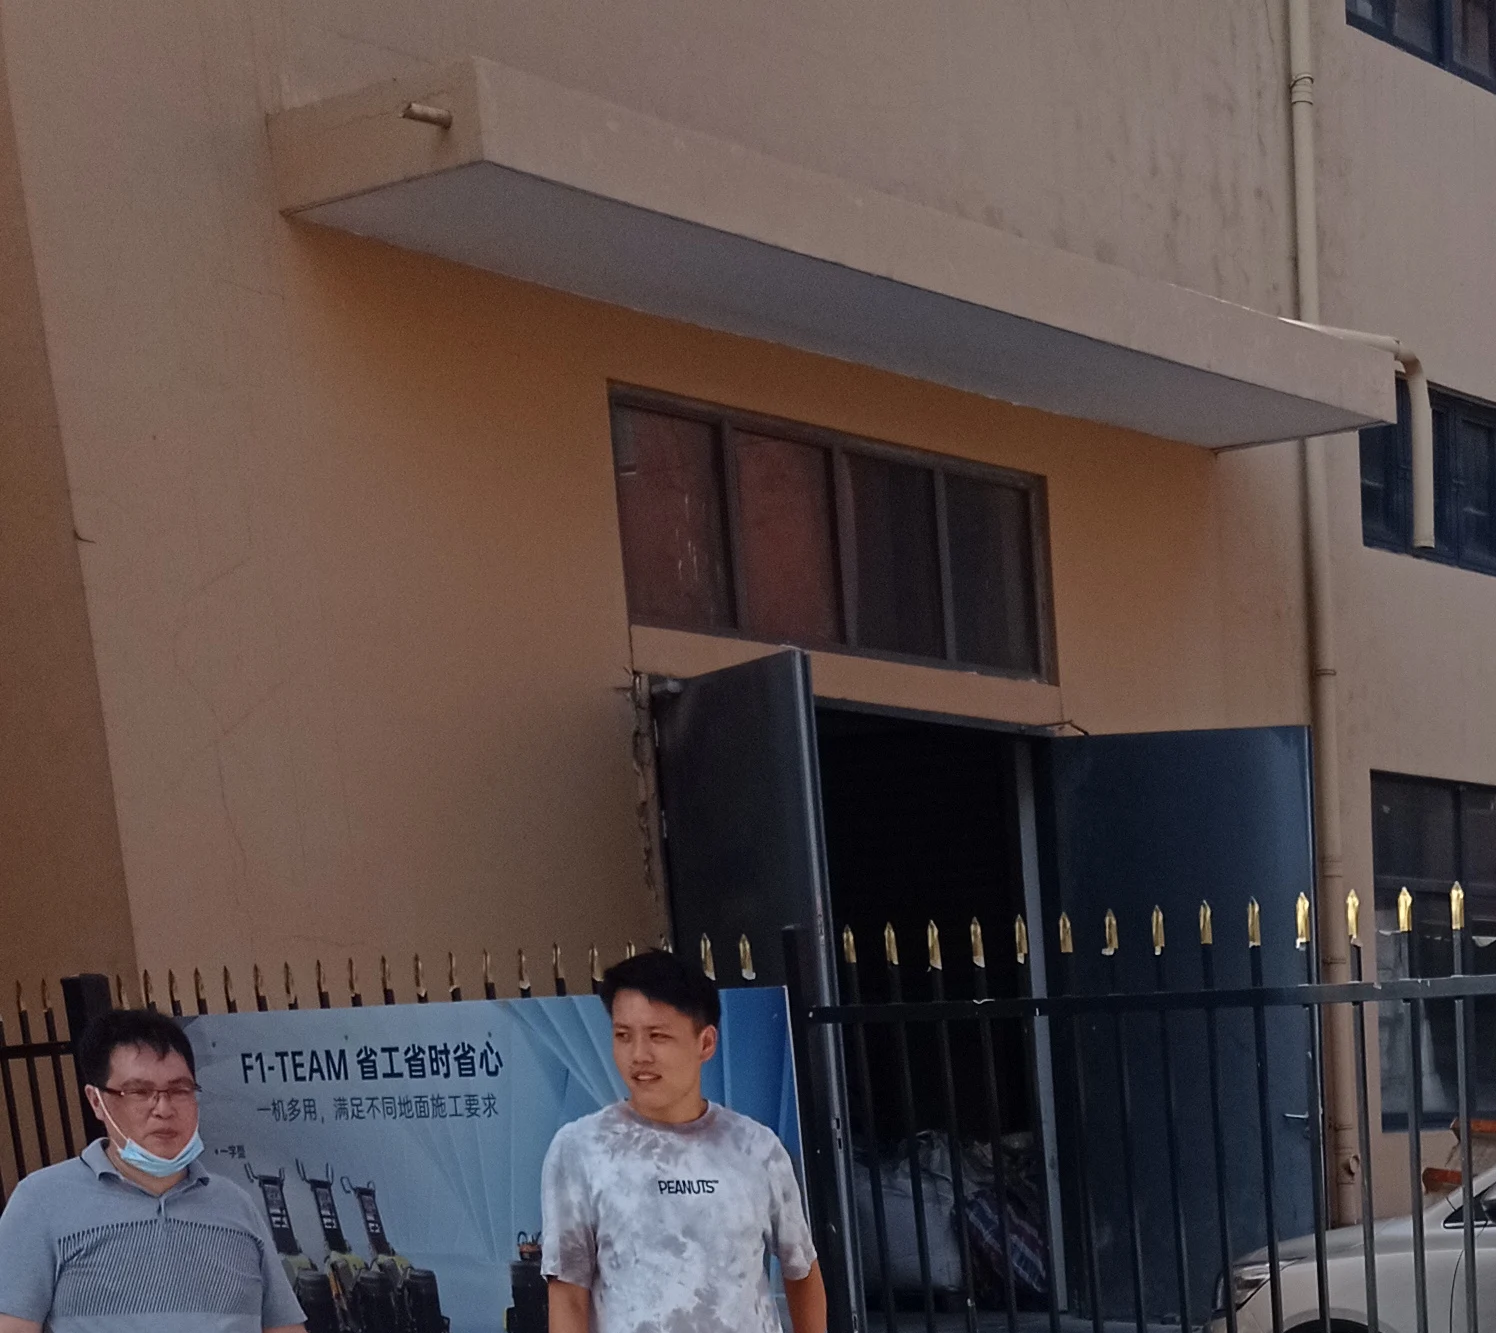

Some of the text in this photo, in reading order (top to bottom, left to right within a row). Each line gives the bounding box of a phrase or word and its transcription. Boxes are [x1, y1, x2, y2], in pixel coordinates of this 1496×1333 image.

[240, 1040, 504, 1084] F1-TEAM 省工省时省心
[657, 1179, 716, 1195] PEANUTS
